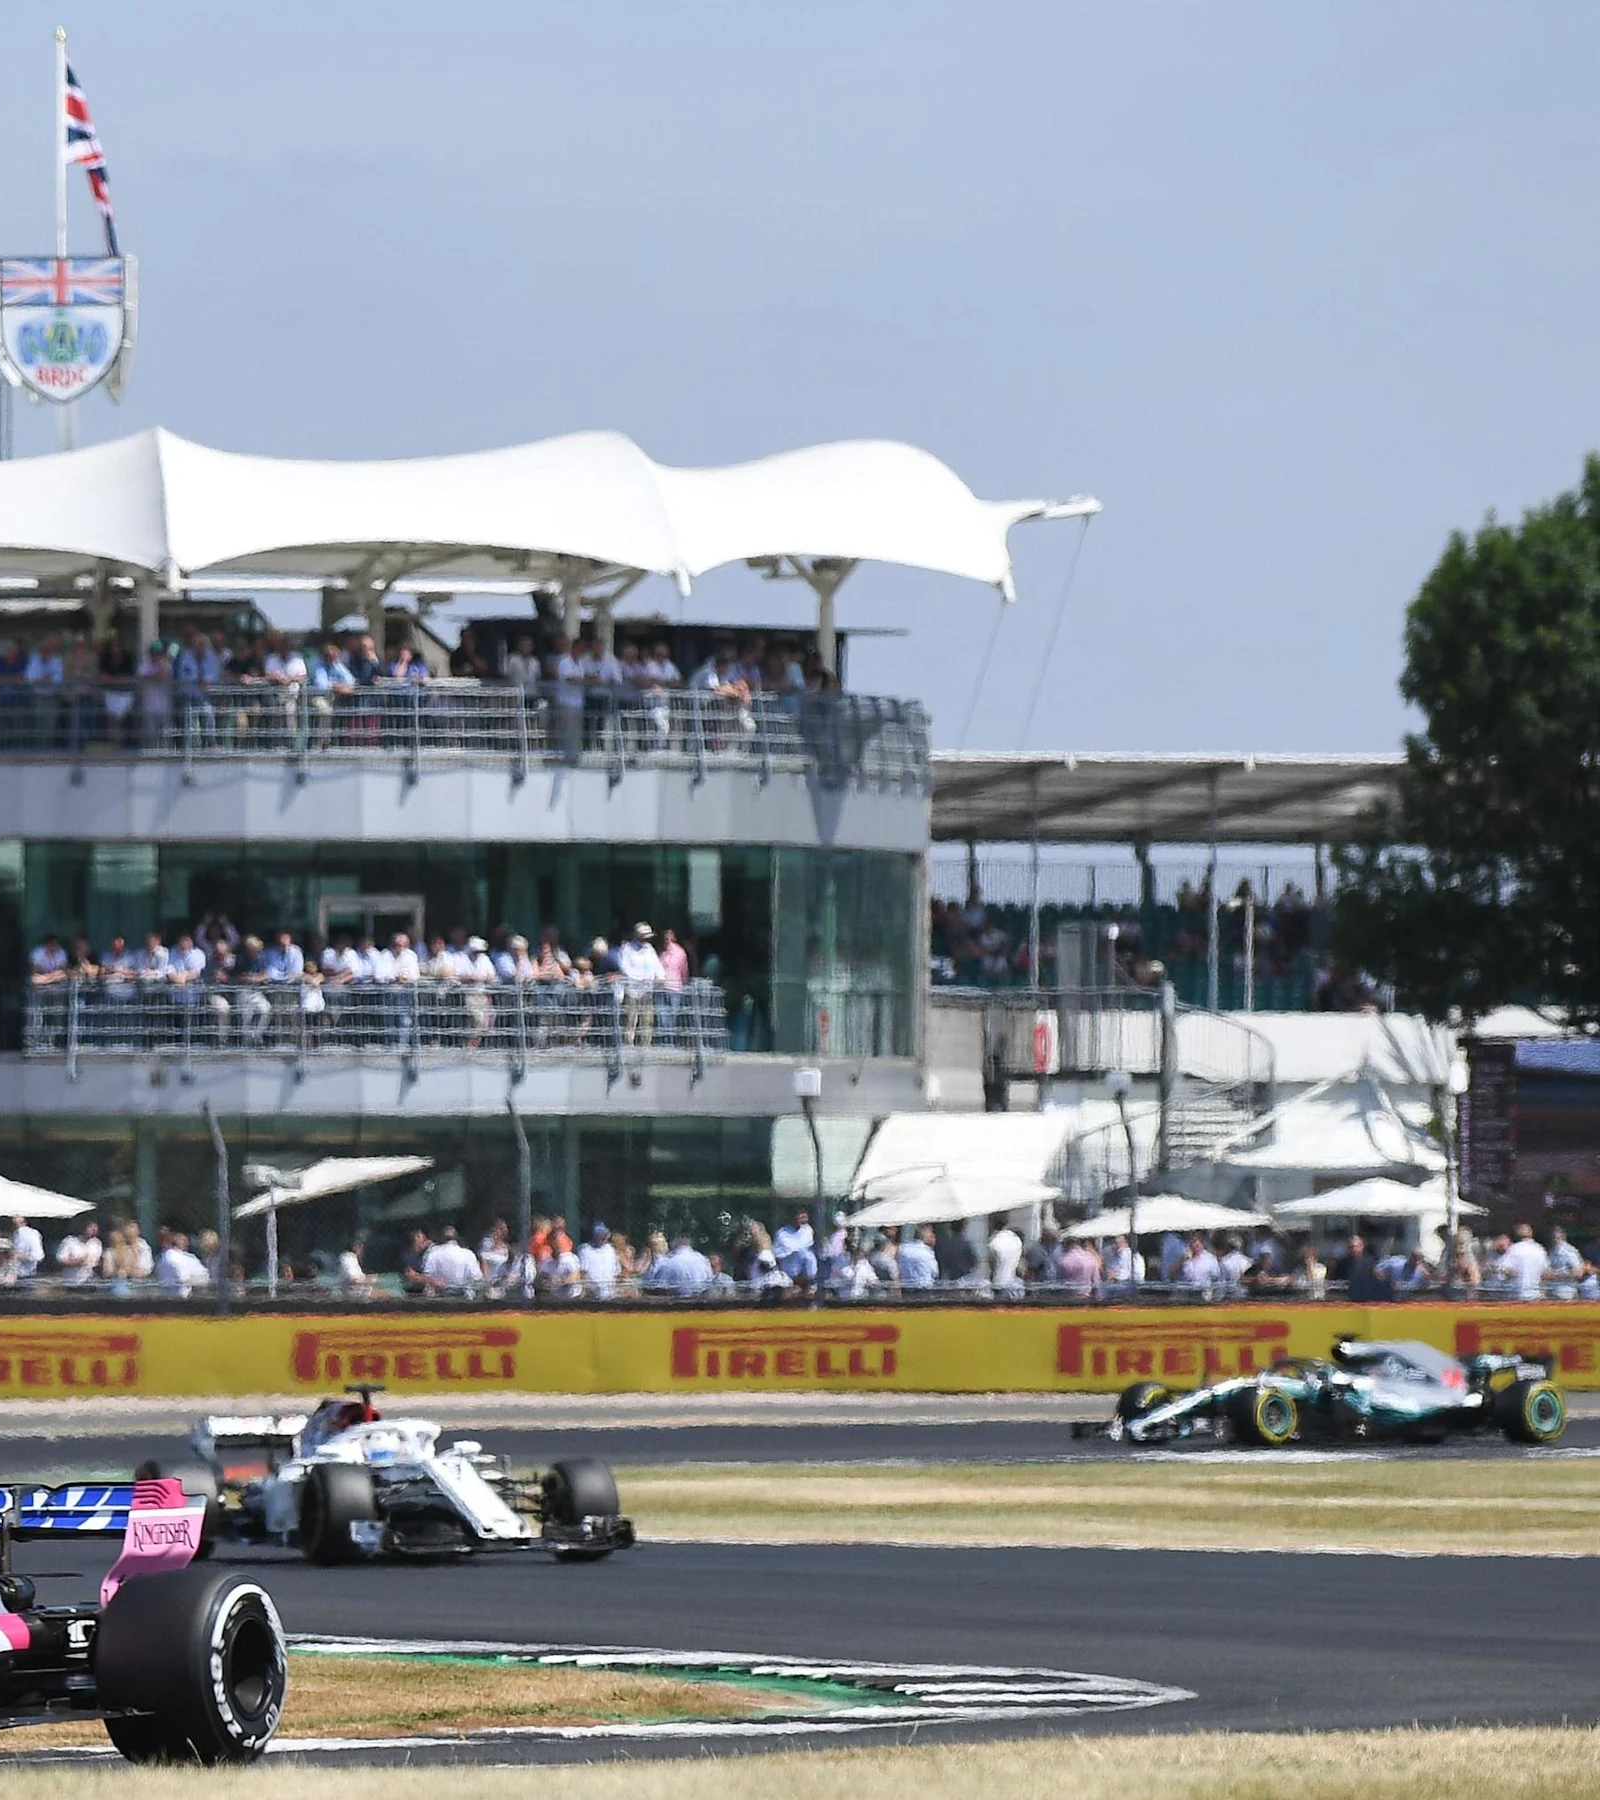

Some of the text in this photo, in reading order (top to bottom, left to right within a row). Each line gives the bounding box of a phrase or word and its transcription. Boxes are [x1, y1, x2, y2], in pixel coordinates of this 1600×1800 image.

[292, 1326, 519, 1381] PIRELLI
[671, 1324, 899, 1378] PIRELLI
[133, 1520, 195, 1552] KINGFISHER
